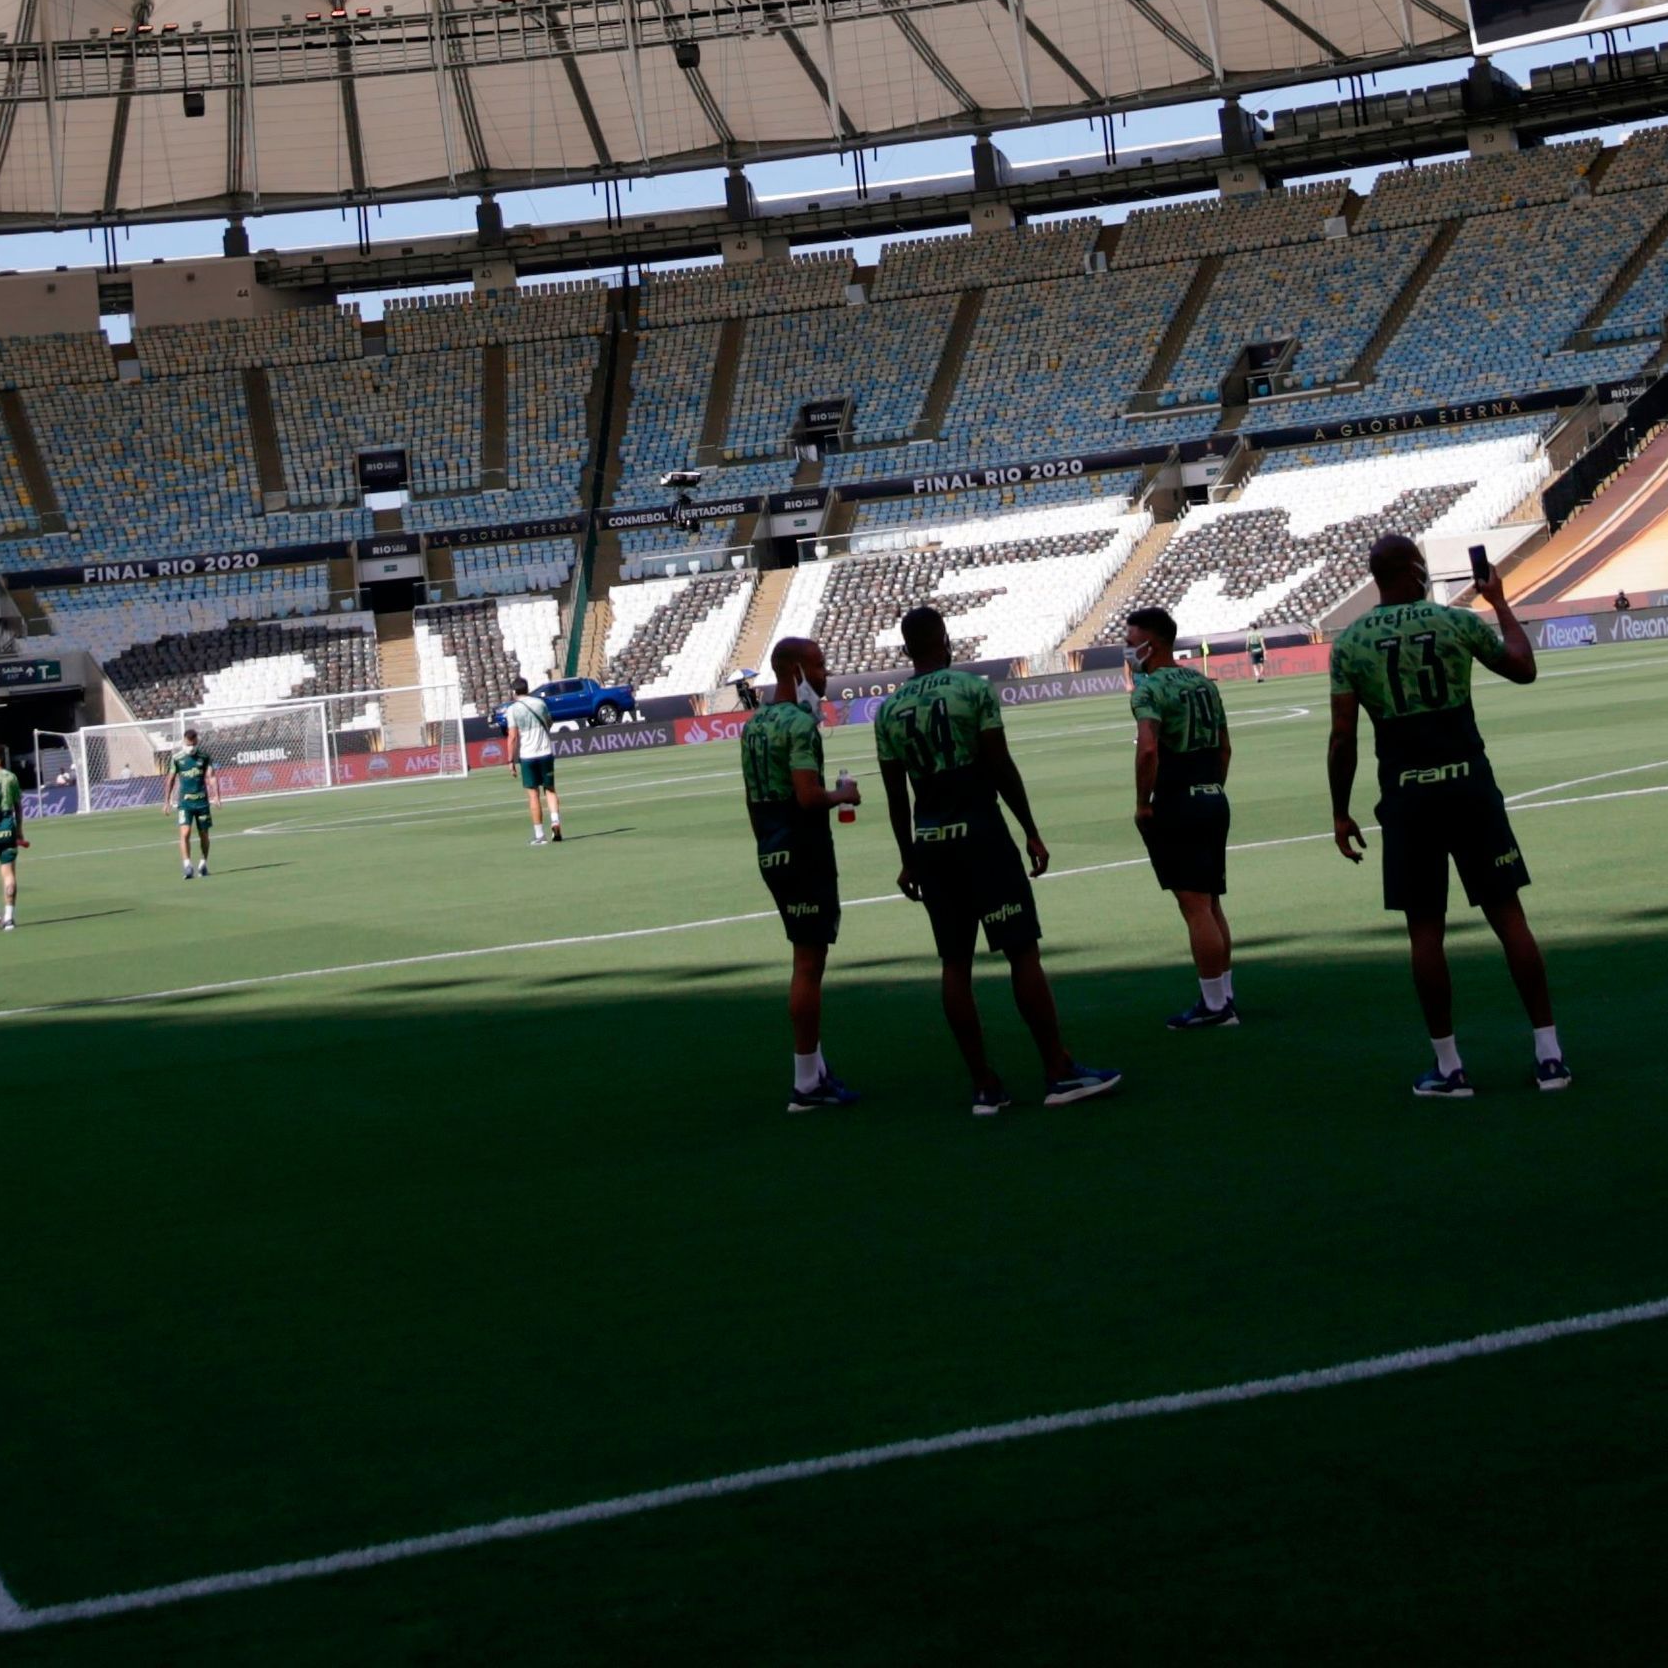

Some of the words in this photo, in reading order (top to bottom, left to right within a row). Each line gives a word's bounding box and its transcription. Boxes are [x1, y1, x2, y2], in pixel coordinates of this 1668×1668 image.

[1484, 134, 1494, 144] 39
[1232, 173, 1244, 183] 40
[984, 209, 995, 219] 41
[736, 241, 748, 251] 42
[480, 270, 492, 279] 43
[237, 289, 249, 298] 44
[811, 413, 827, 423] RIO
[1314, 429, 1326, 441] A
[1440, 401, 1522, 424] ETERNA
[913, 473, 977, 494] FINAL
[985, 467, 1022, 486] RIO
[1030, 460, 1083, 479] 2020
[784, 500, 802, 510] RIO
[609, 511, 668, 528] CONMEBOL
[524, 523, 579, 536] ETERNA
[372, 546, 391, 555] RIO
[83, 563, 150, 583] FINAL
[157, 557, 196, 576] RIO
[205, 552, 260, 572] 2020
[1365, 607, 1433, 628] crefisa
[1547, 621, 1596, 647] Rexona
[1374, 630, 1448, 715] 13
[1001, 681, 1063, 705] QATAR
[1068, 674, 1126, 696] AIRWA
[590, 727, 668, 753] AIRWAYS
[1399, 760, 1470, 788] Fam
[758, 850, 790, 869] am
[984, 901, 1023, 925] crefisa
